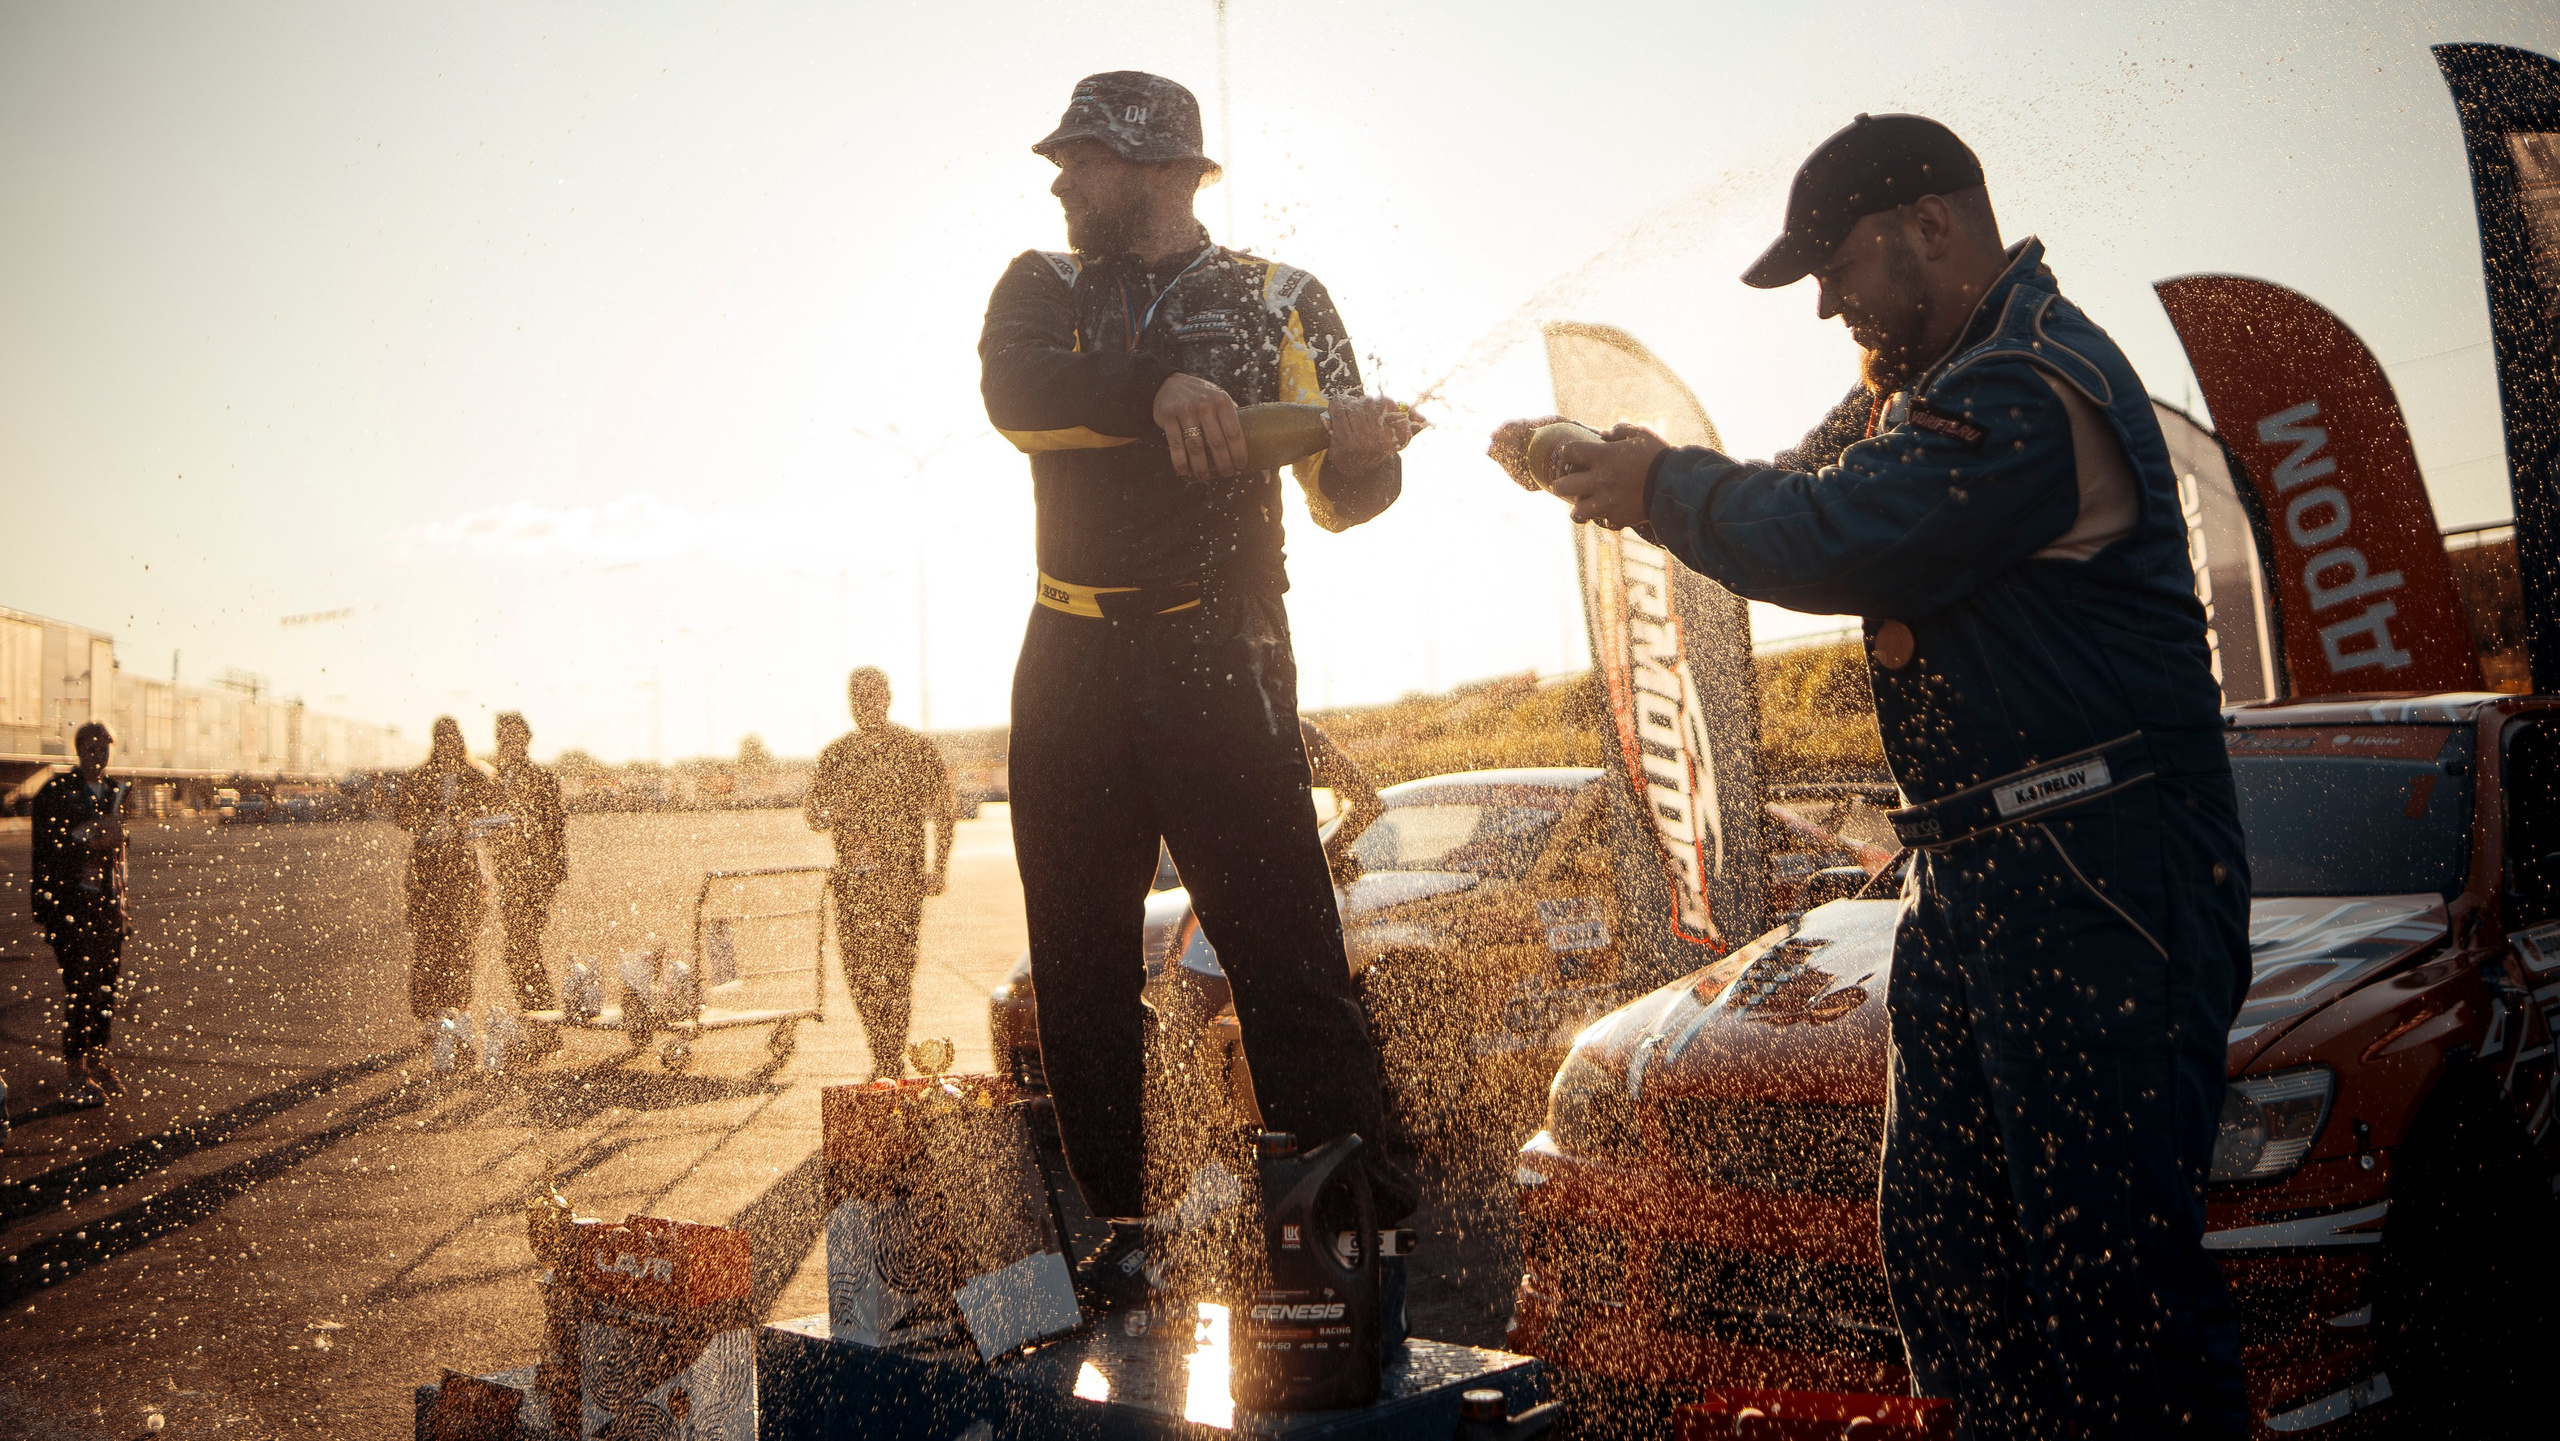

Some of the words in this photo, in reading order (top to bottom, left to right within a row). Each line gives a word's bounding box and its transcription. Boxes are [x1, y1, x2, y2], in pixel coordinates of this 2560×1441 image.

[1125, 105, 1147, 124] 01
[2014, 770, 2087, 804] K.STRELOV
[2404, 774, 2437, 818] 1
[1250, 1303, 1345, 1319] GENESIS
[1320, 1327, 1350, 1335] RACING
